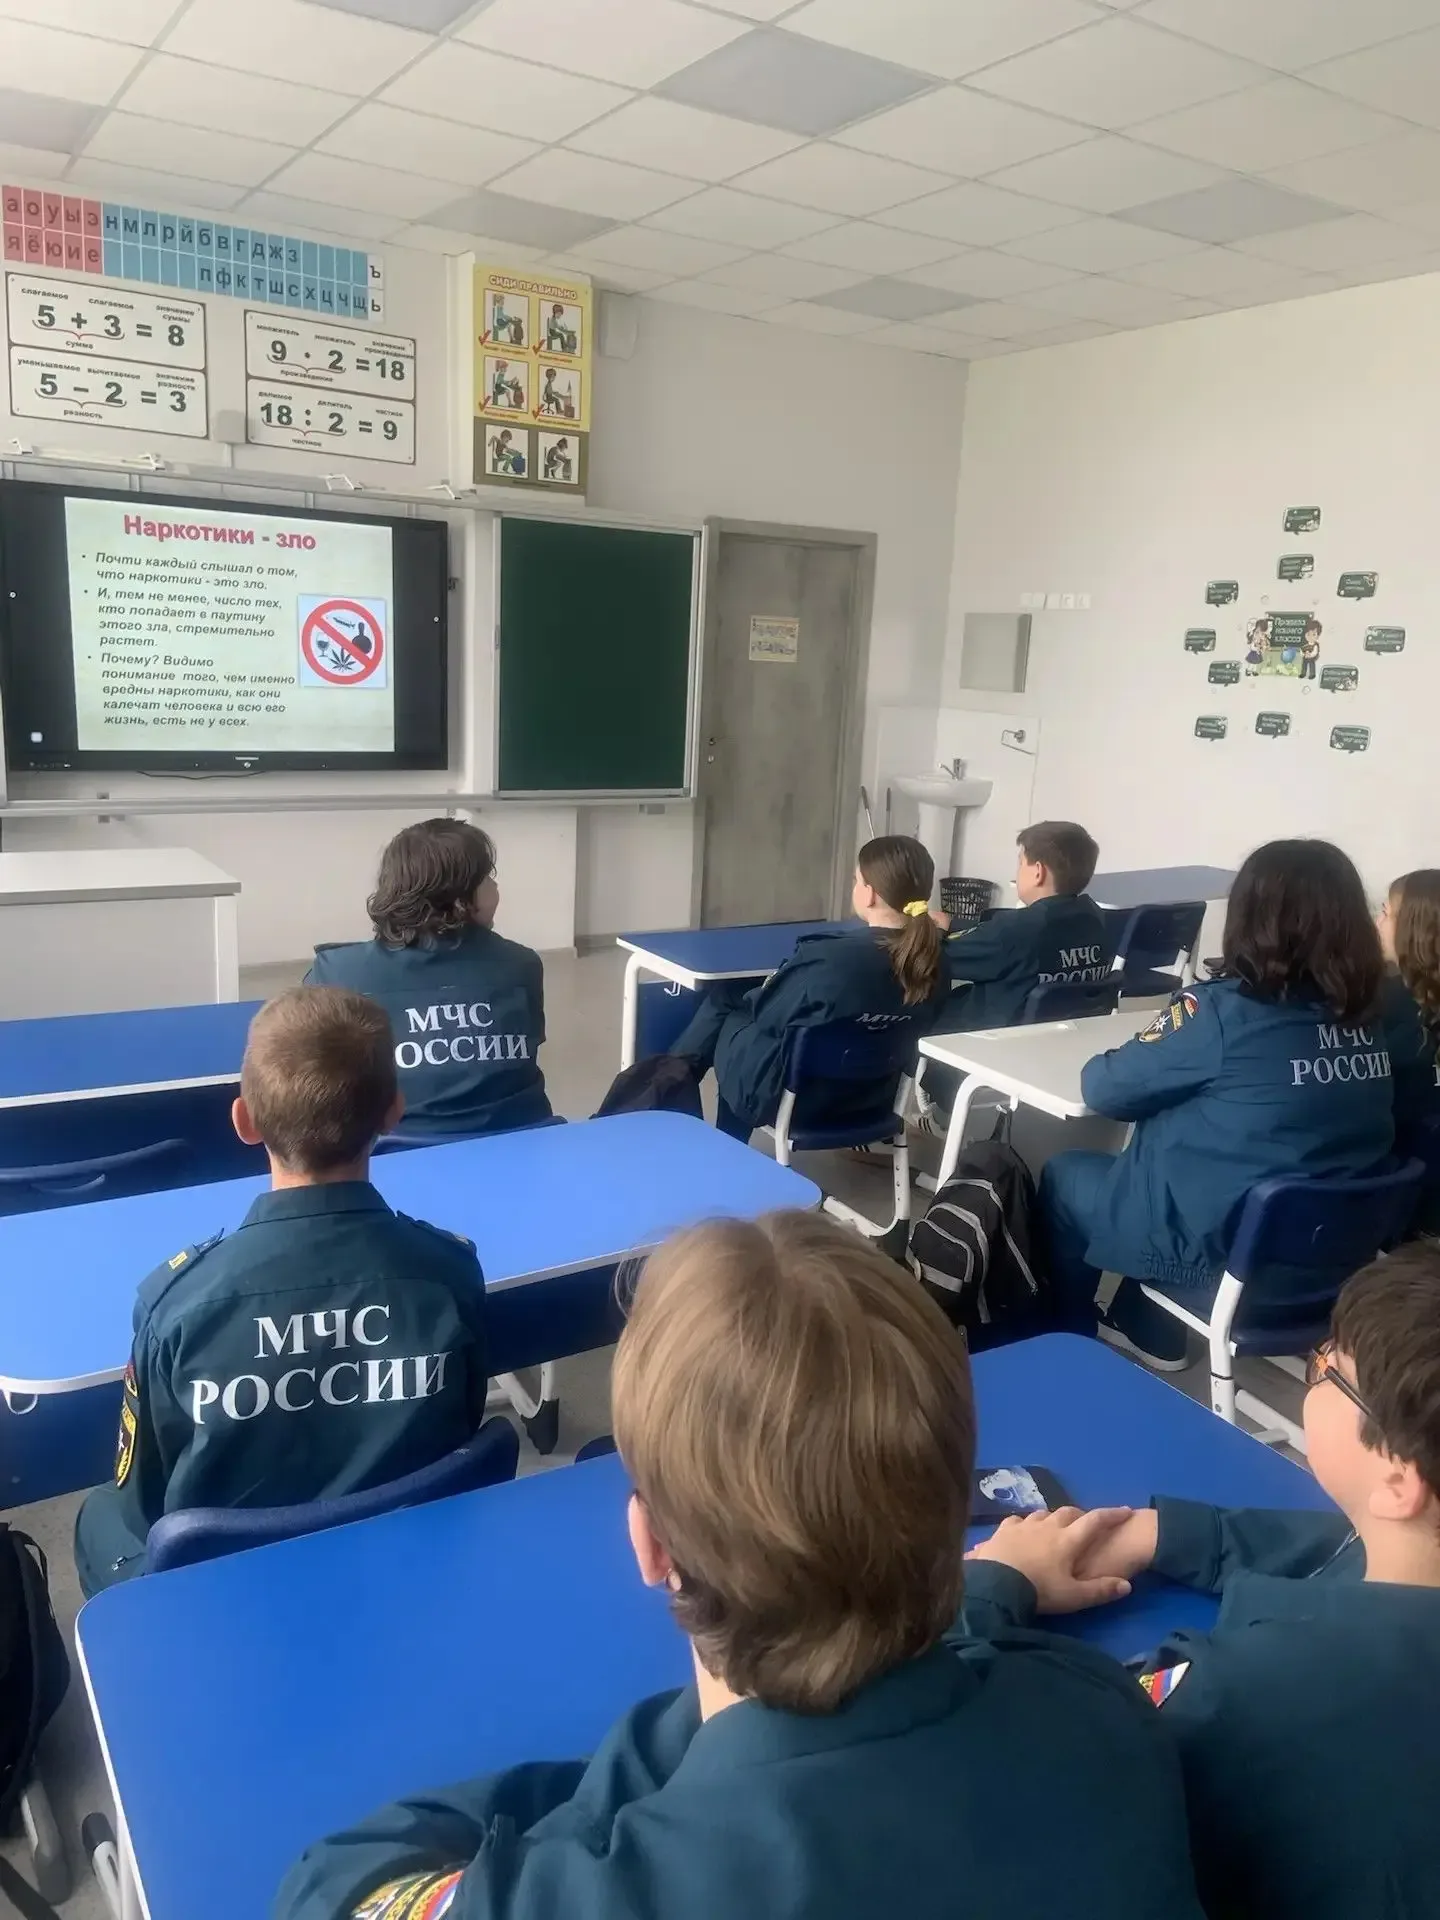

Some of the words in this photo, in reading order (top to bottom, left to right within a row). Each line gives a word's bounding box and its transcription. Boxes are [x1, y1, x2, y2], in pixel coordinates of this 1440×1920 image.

[489, 275, 518, 288] СИДИ
[518, 280, 577, 300] ПРАВИЛЬНО
[37, 304, 55, 327] 5
[104, 314, 121, 337] 3
[168, 324, 185, 347] 8
[271, 340, 287, 361] 9
[328, 349, 343, 371] 2
[376, 358, 405, 381] 18
[40, 373, 58, 396] 5
[105, 382, 123, 404] 2
[169, 390, 186, 412] 3
[261, 402, 293, 426] 18
[328, 412, 344, 433] 2
[383, 420, 398, 441] 9
[123, 514, 255, 545] Наркотики
[276, 533, 316, 550] зло
[95, 552, 141, 565] Почти
[146, 557, 197, 570] каждый
[200, 561, 253, 574] слышал
[268, 567, 298, 578] том,
[97, 571, 125, 580] что
[129, 573, 202, 585] наркотики
[213, 578, 239, 588] это
[243, 581, 267, 590] зло.
[98, 587, 110, 600] И,
[115, 591, 144, 600] тем
[148, 593, 164, 601] не
[167, 594, 210, 606] менее,
[215, 596, 251, 606] число
[255, 599, 282, 609] тех,
[98, 605, 126, 614] кто
[129, 606, 196, 618] попадает
[200, 611, 207, 619] в
[211, 611, 266, 625] паутину
[99, 620, 142, 631] этого
[146, 622, 172, 634] зла,
[176, 624, 275, 638] стремительно
[99, 635, 158, 647] растет.
[101, 652, 160, 668] Почему?
[163, 655, 214, 667] Видимо
[101, 670, 176, 681] понимание
[183, 673, 219, 683] того,
[224, 674, 247, 683] чем
[250, 675, 296, 684] именно
[102, 684, 155, 696] вредны
[158, 687, 232, 698] наркотики,
[236, 689, 256, 698] как
[258, 690, 281, 698] они
[103, 701, 161, 710] калечат
[164, 702, 223, 712] человека
[238, 704, 262, 712] всю
[104, 716, 148, 726] жизнь,
[152, 717, 187, 726] есть
[190, 718, 205, 726] не
[208, 718, 216, 728] у
[1059, 945, 1101, 968] МЧС
[405, 1002, 494, 1033] МЧС
[394, 1034, 531, 1069] ОССИИ
[253, 1304, 390, 1359] МЧС
[189, 1351, 452, 1425] РОССИИ
